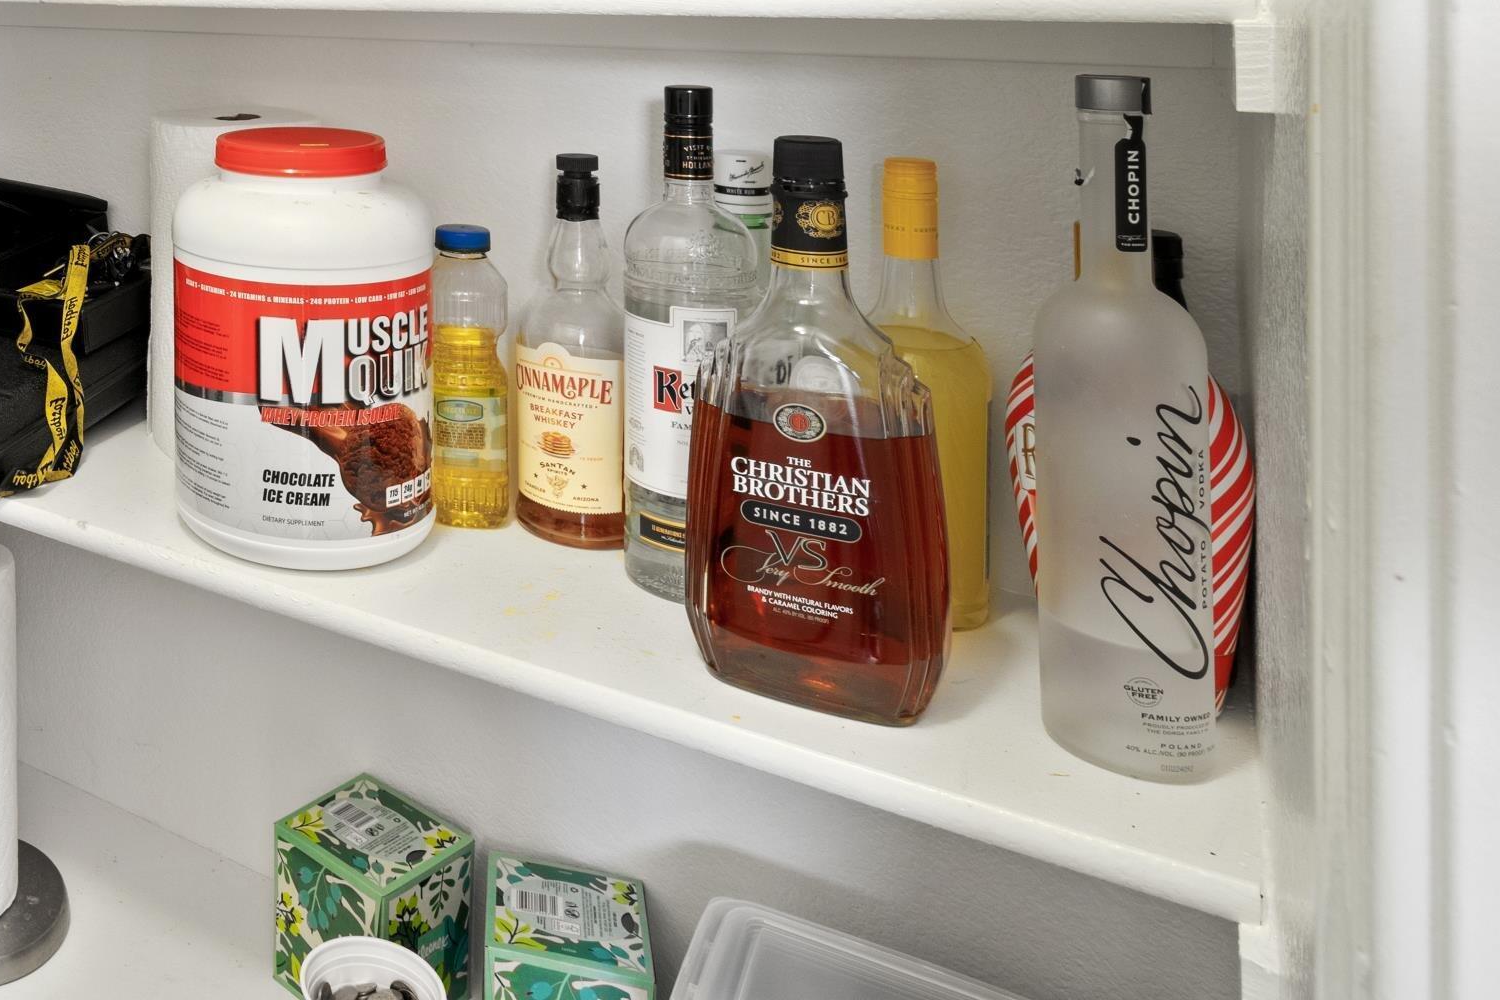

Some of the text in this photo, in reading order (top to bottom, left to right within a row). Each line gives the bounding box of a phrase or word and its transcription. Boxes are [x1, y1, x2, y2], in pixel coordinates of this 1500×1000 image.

[1127, 150, 1140, 225] CHOPIN
[816, 210, 836, 226] CB
[229, 290, 236, 298] 24
[237, 291, 266, 302] VITAMINS
[272, 296, 305, 305] MINERALS
[323, 296, 350, 305] PROTEIN
[354, 296, 368, 304] LOW
[259, 304, 429, 405] MUSCLE
[348, 341, 429, 406] QUIK
[516, 363, 613, 405] CINNAMAPLE
[261, 406, 400, 427] WHEY PROTEIN ISOLATE
[529, 402, 584, 421] BREAKFAST
[533, 413, 576, 430] WHISKEY
[786, 455, 812, 469] THE
[262, 468, 336, 488] CHOCOLATE
[730, 456, 871, 498] CHRISTIAN
[262, 488, 331, 507] ICE CREAM
[732, 473, 869, 517] BROTHERS
[262, 515, 325, 527] DIETARY SUPPLEMENT
[753, 507, 848, 535] SINCE 1882
[1099, 384, 1212, 680] Chopin
[1197, 449, 1208, 610] POTATO VODKA
[765, 529, 827, 571] VS
[747, 584, 854, 615] BRANDY WITH NATURAL FLAVORS
[1123, 684, 1164, 695] GLUTEN
[1131, 692, 1158, 700] FREE
